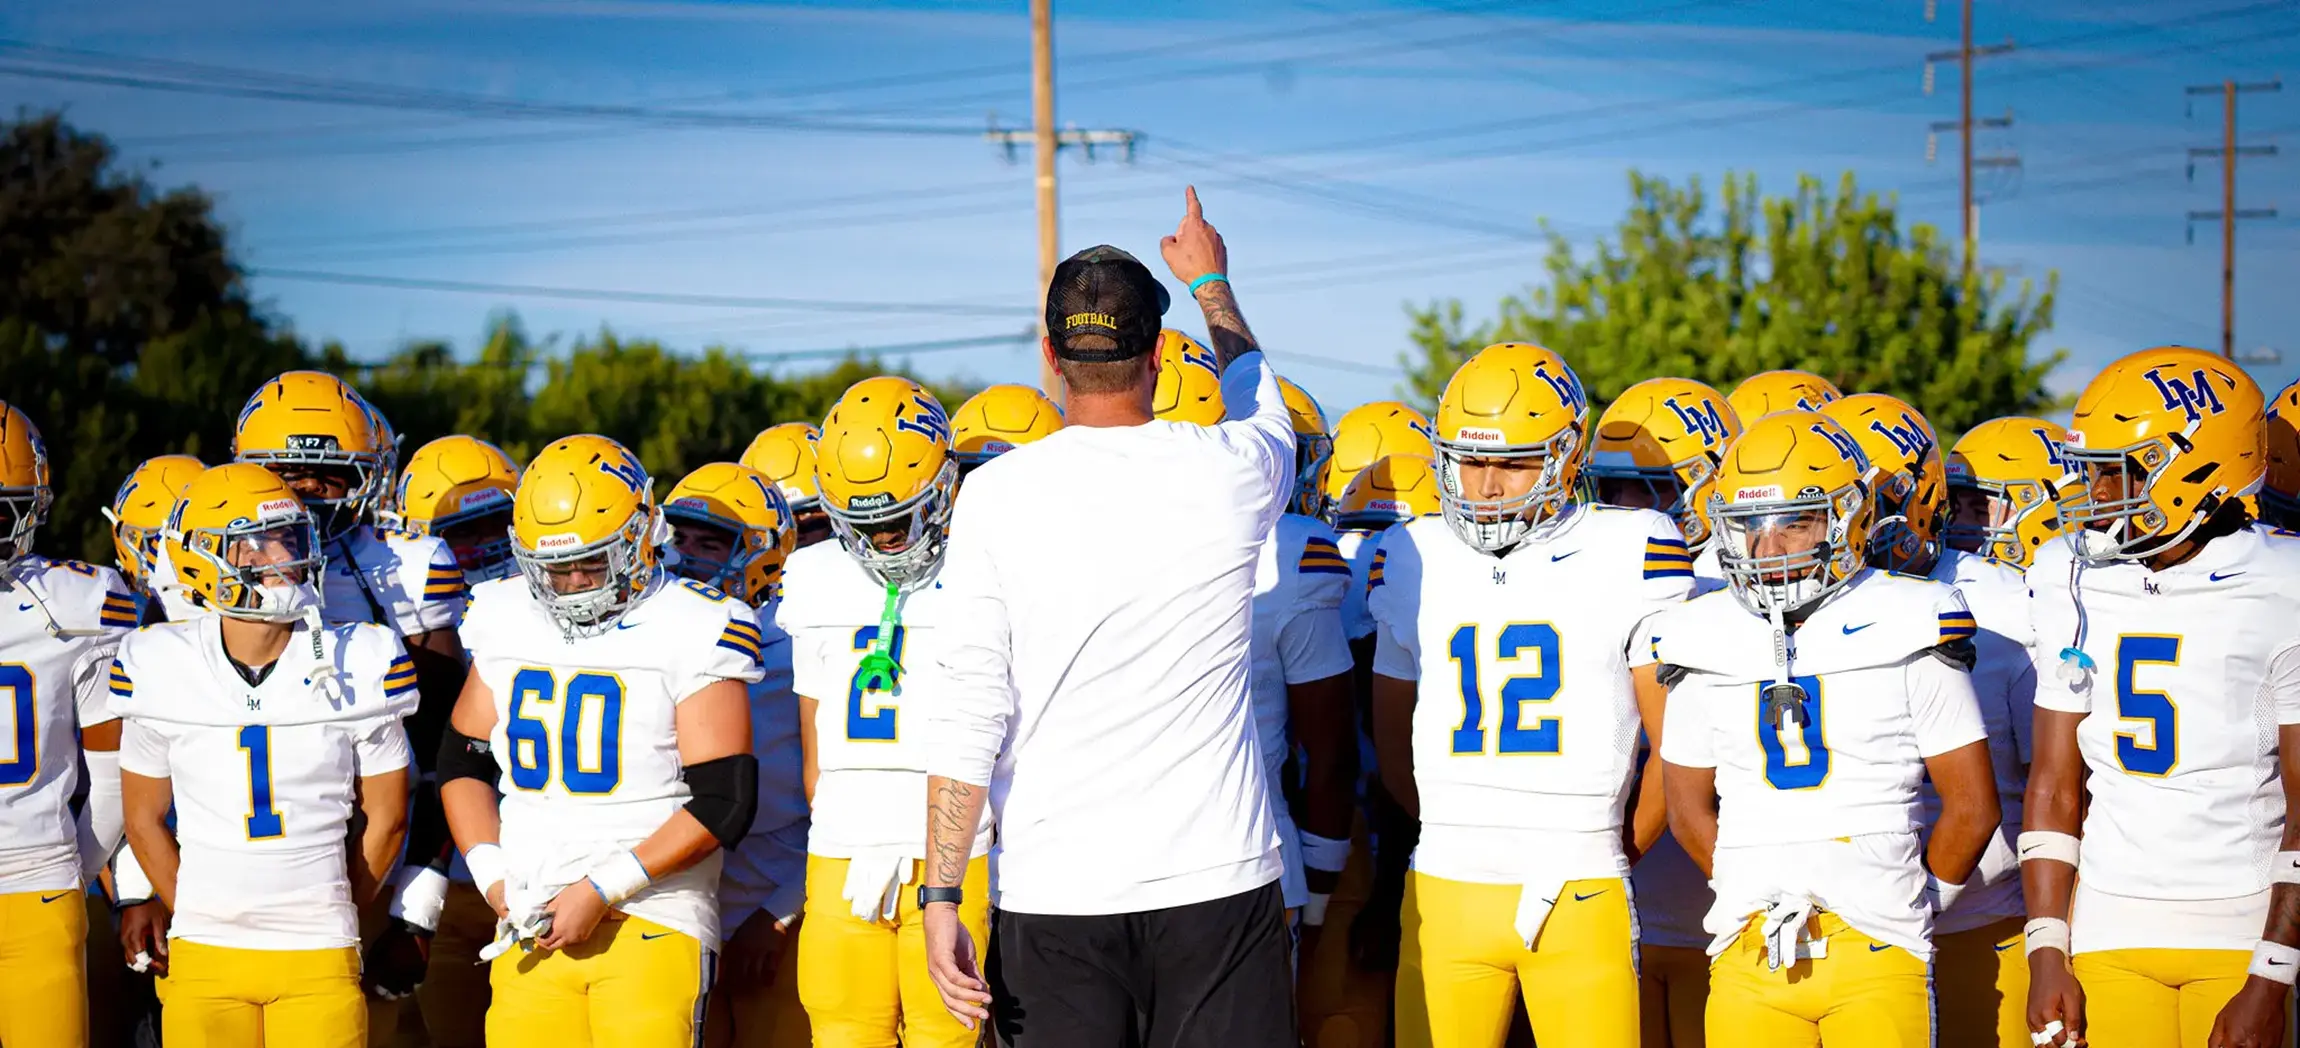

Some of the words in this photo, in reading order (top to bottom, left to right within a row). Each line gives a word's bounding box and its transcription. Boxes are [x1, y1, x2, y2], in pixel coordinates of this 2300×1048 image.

[1065, 312, 1117, 330] FOOTBALL
[2143, 368, 2226, 424] LM
[896, 394, 952, 444] LM
[1664, 397, 1729, 447] LM
[305, 438, 320, 447] F7
[1461, 429, 1499, 441] Riddell
[1869, 411, 1934, 458] LM
[1810, 423, 1871, 475] LM
[850, 494, 889, 508] Riddell
[1738, 487, 1777, 500] Riddell
[262, 500, 295, 511] Riddell
[1369, 501, 1407, 511] Riddell
[539, 536, 577, 549] Riddell
[1493, 566, 1507, 585] LM
[2143, 576, 2161, 595] LM
[1447, 620, 1563, 756] 12
[246, 694, 261, 711] LM
[2112, 632, 2184, 778] 5
[505, 666, 627, 795] 60
[236, 724, 287, 842] 1
